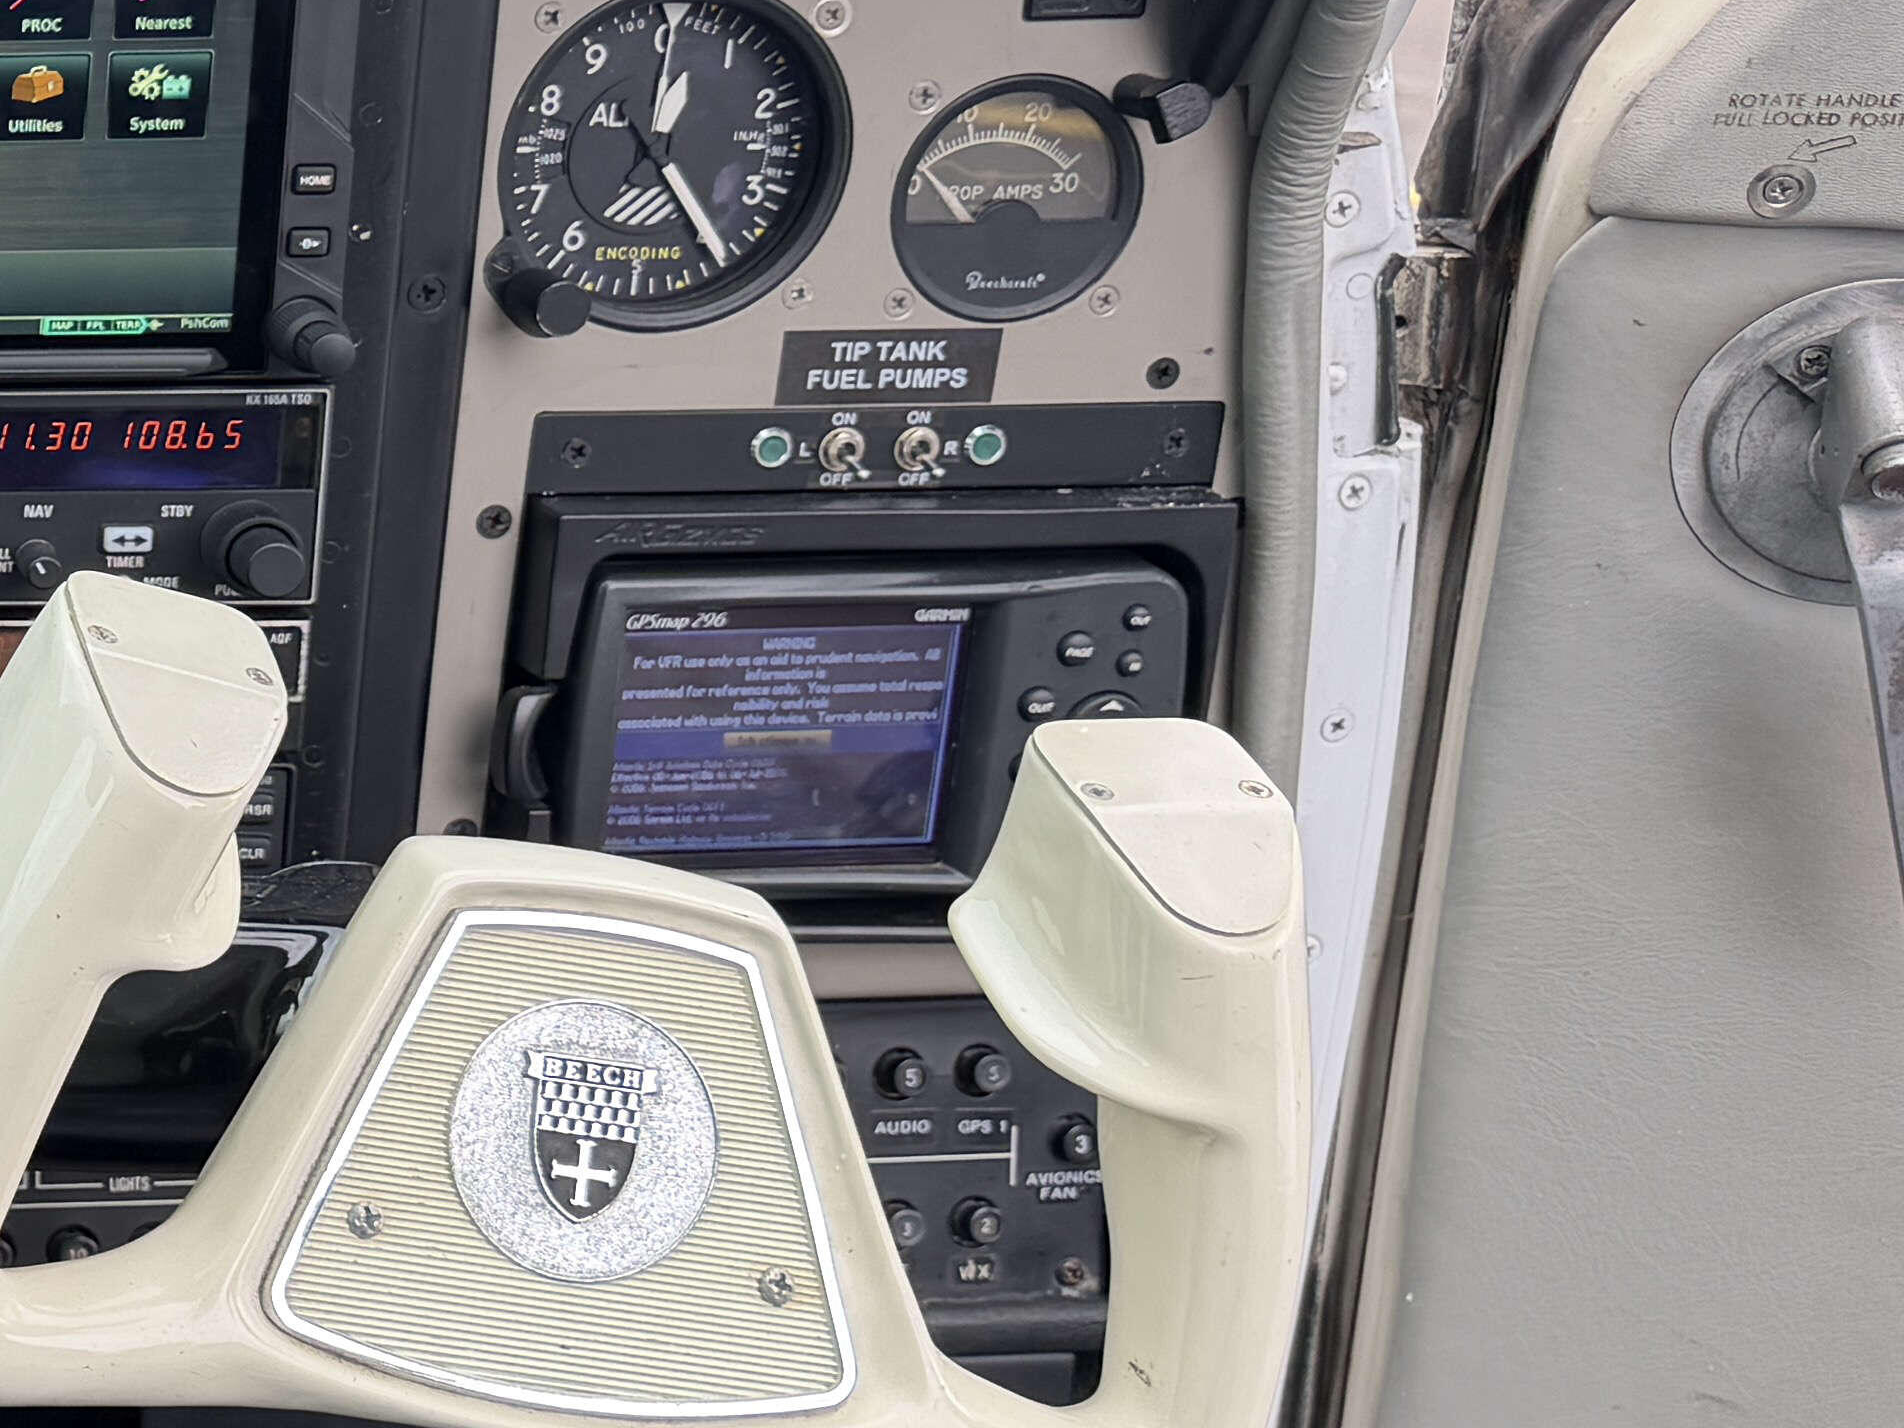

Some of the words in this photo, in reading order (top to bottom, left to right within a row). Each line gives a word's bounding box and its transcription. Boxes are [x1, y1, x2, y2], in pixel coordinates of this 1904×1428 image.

[20, 17, 62, 34] PROC
[134, 15, 193, 30] Nearest
[1728, 93, 1805, 108] ROTATE
[1816, 93, 1903, 108] HANDLE
[8, 117, 63, 134] Utilities
[129, 116, 184, 133] System
[1763, 112, 1841, 126] LOCKED
[830, 342, 871, 362] TIP
[877, 340, 945, 361] TANK
[807, 369, 869, 390] FUEL
[871, 367, 969, 389] PUMPS
[122, 419, 245, 450] 108.65
[543, 1058, 642, 1087] BEECH
